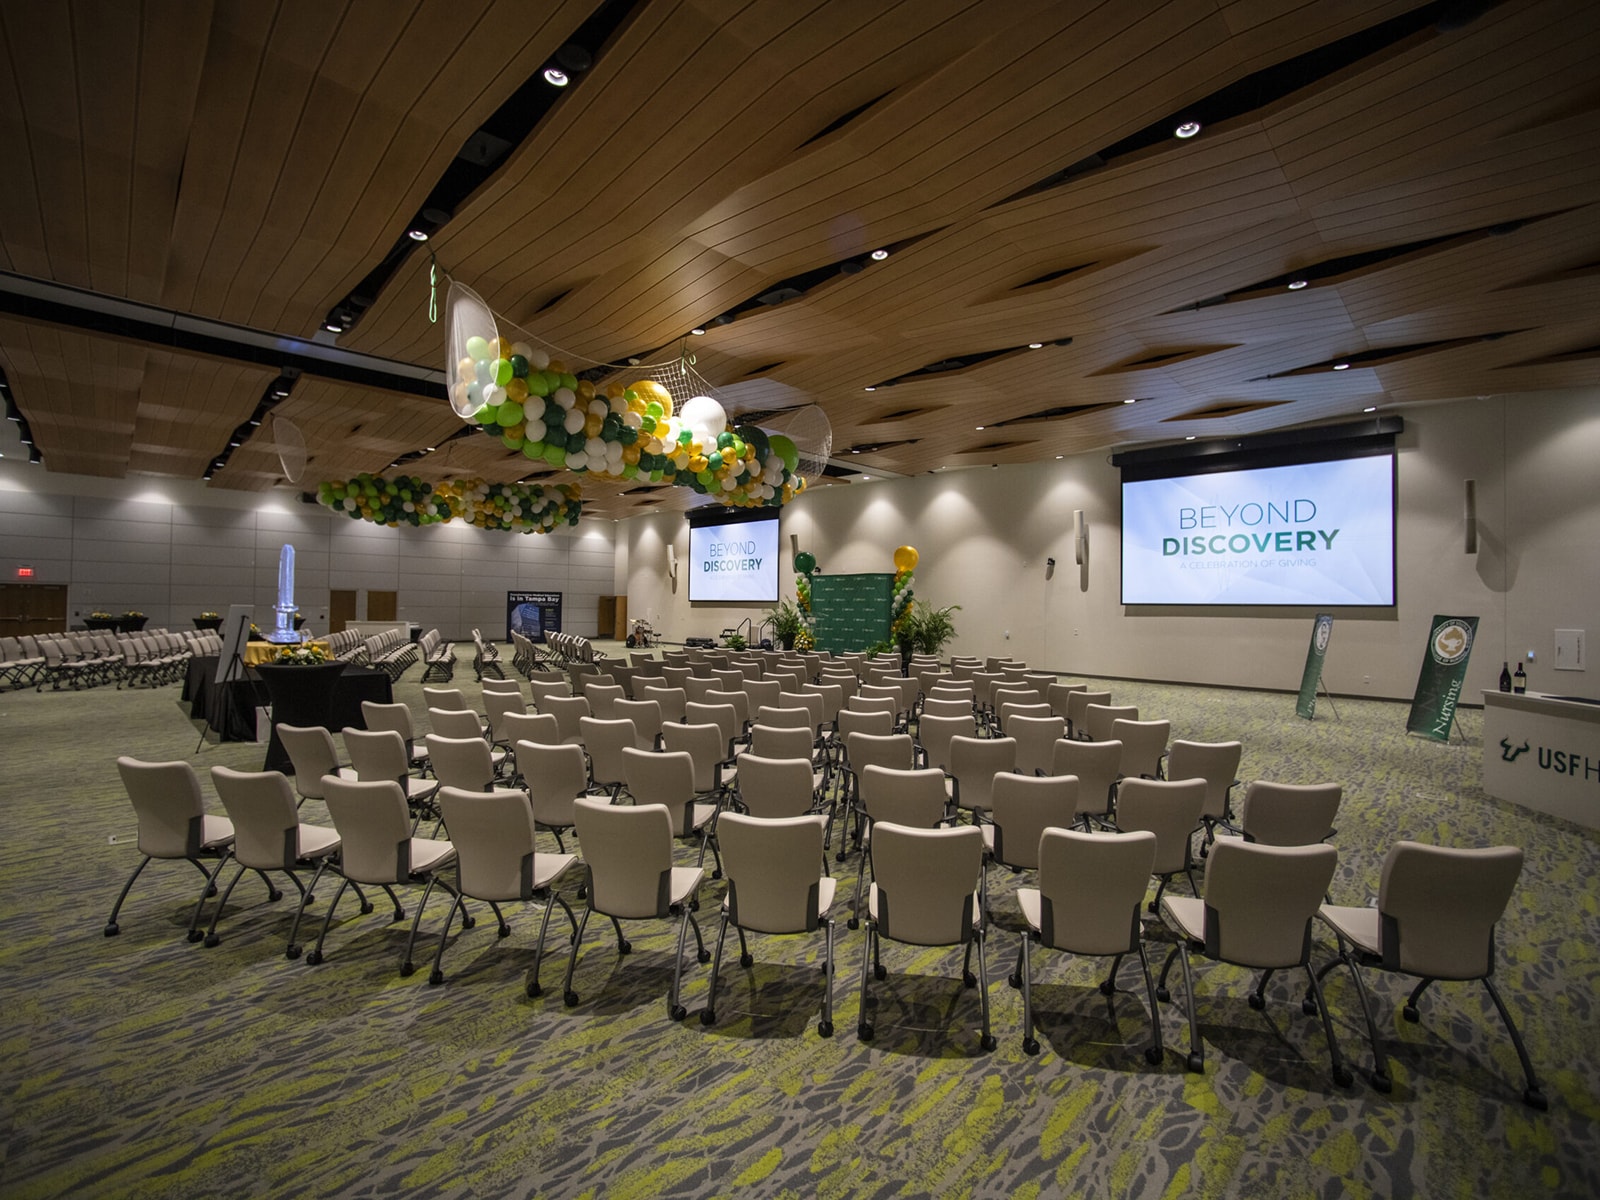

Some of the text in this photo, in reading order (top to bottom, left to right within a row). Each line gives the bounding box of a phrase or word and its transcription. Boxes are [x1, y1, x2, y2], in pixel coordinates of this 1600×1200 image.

[1180, 498, 1317, 530] BEYOND
[709, 540, 756, 557] BEYOND
[1162, 529, 1340, 556] DISCOVERY
[703, 558, 762, 572] DISCOVERY
[1180, 557, 1317, 570] A CELEBRATION OF GIVING
[1432, 679, 1461, 735] Nursing
